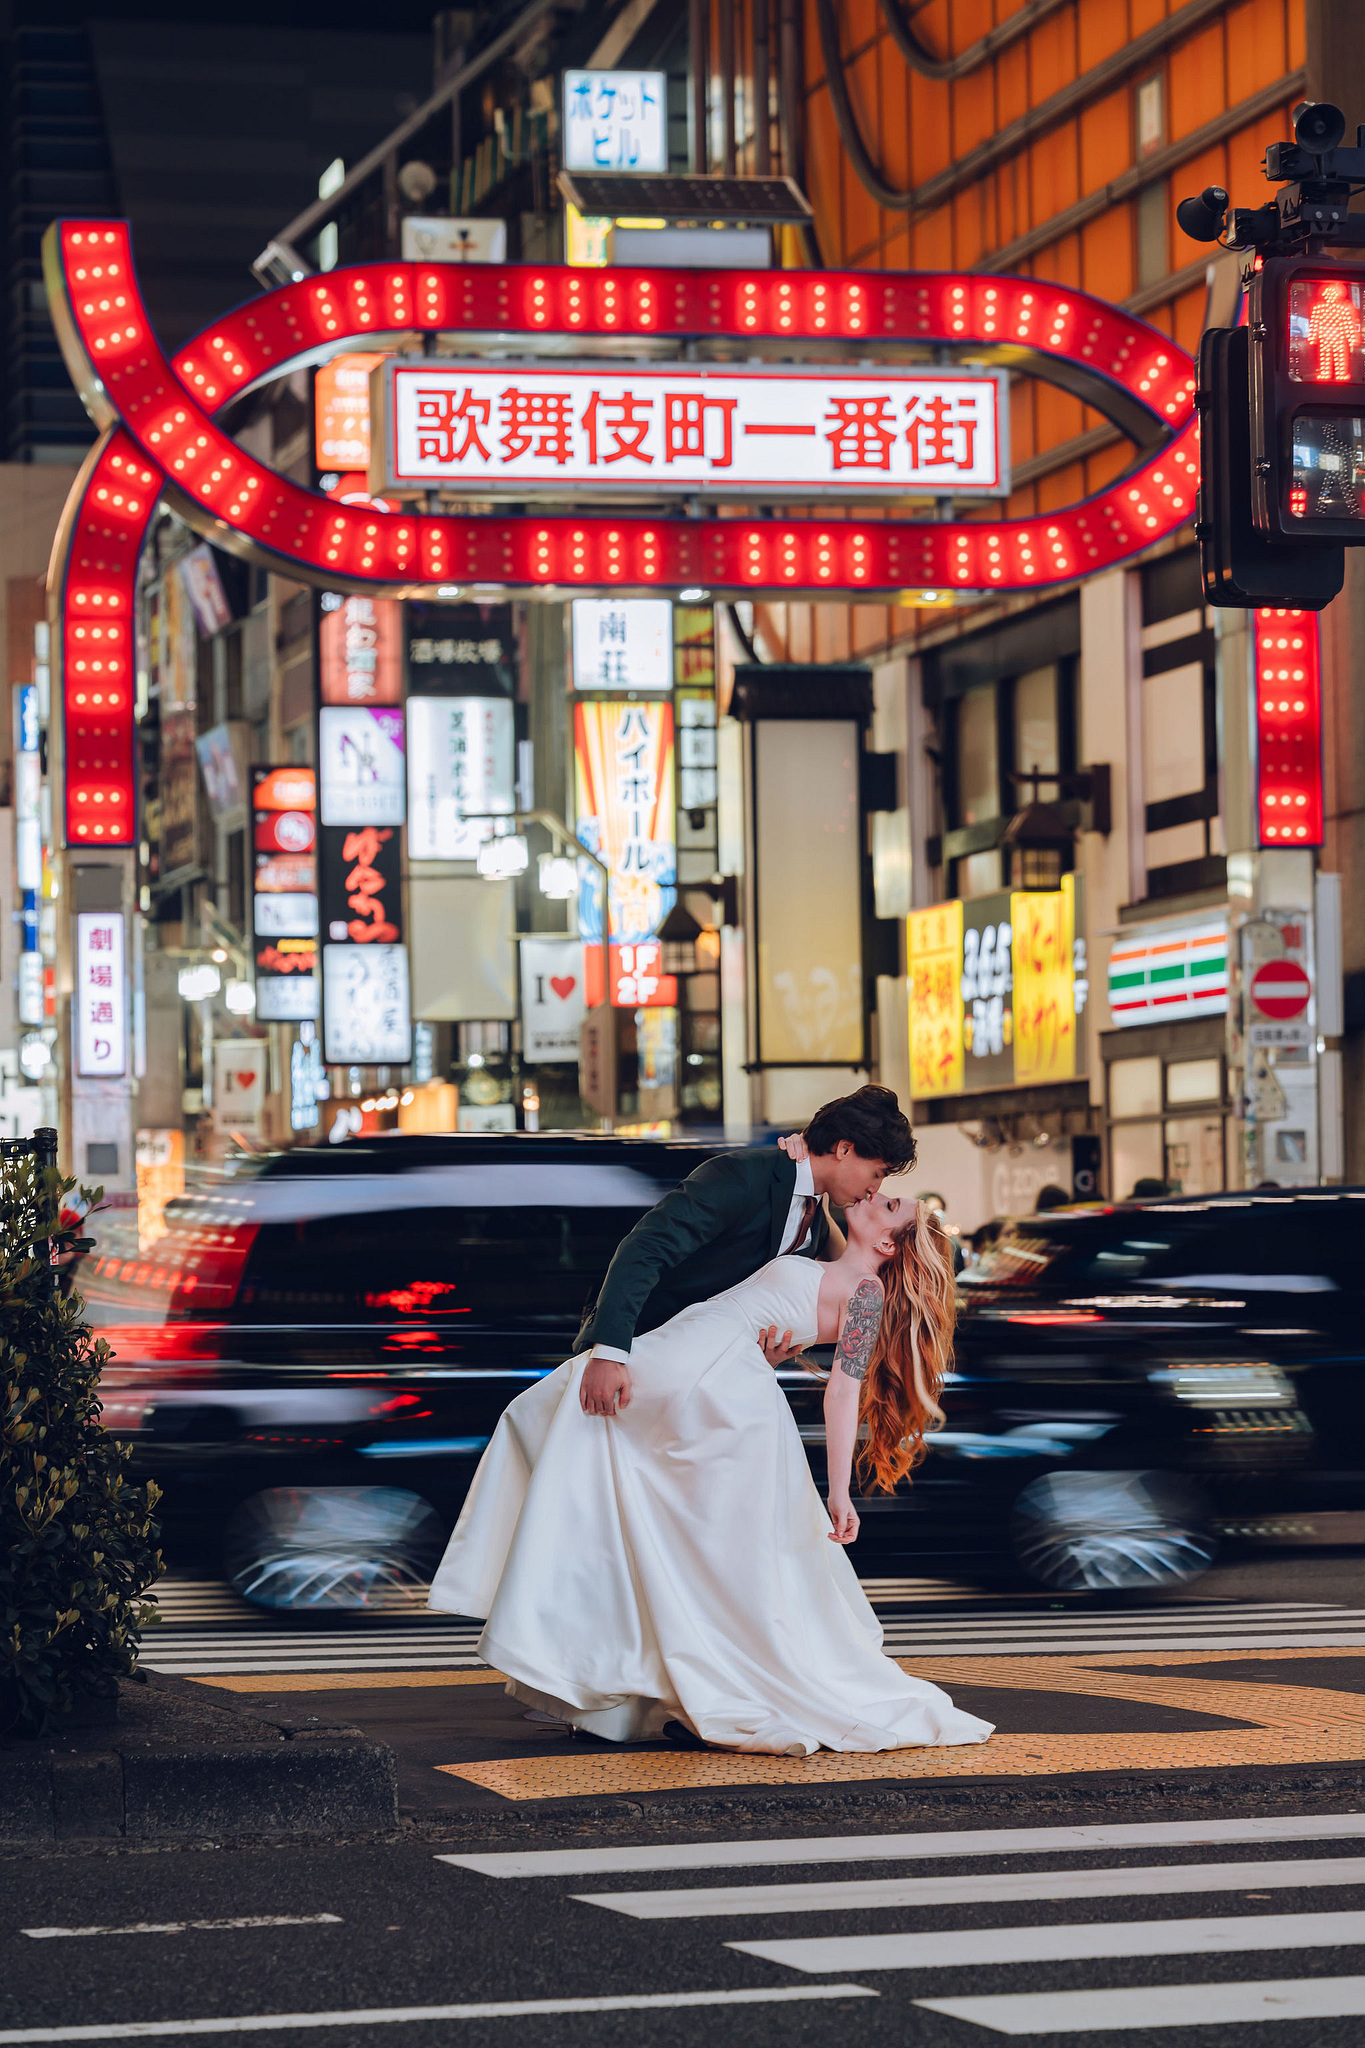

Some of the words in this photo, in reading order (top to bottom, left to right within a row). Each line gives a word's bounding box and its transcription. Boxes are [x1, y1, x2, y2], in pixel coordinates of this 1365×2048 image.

[570, 78, 655, 120] ポケット
[592, 126, 640, 169] ビル
[415, 387, 978, 470] 歌舞伎町一番街
[619, 711, 654, 871] ハイボール
[88, 928, 113, 1061] 劇場通り
